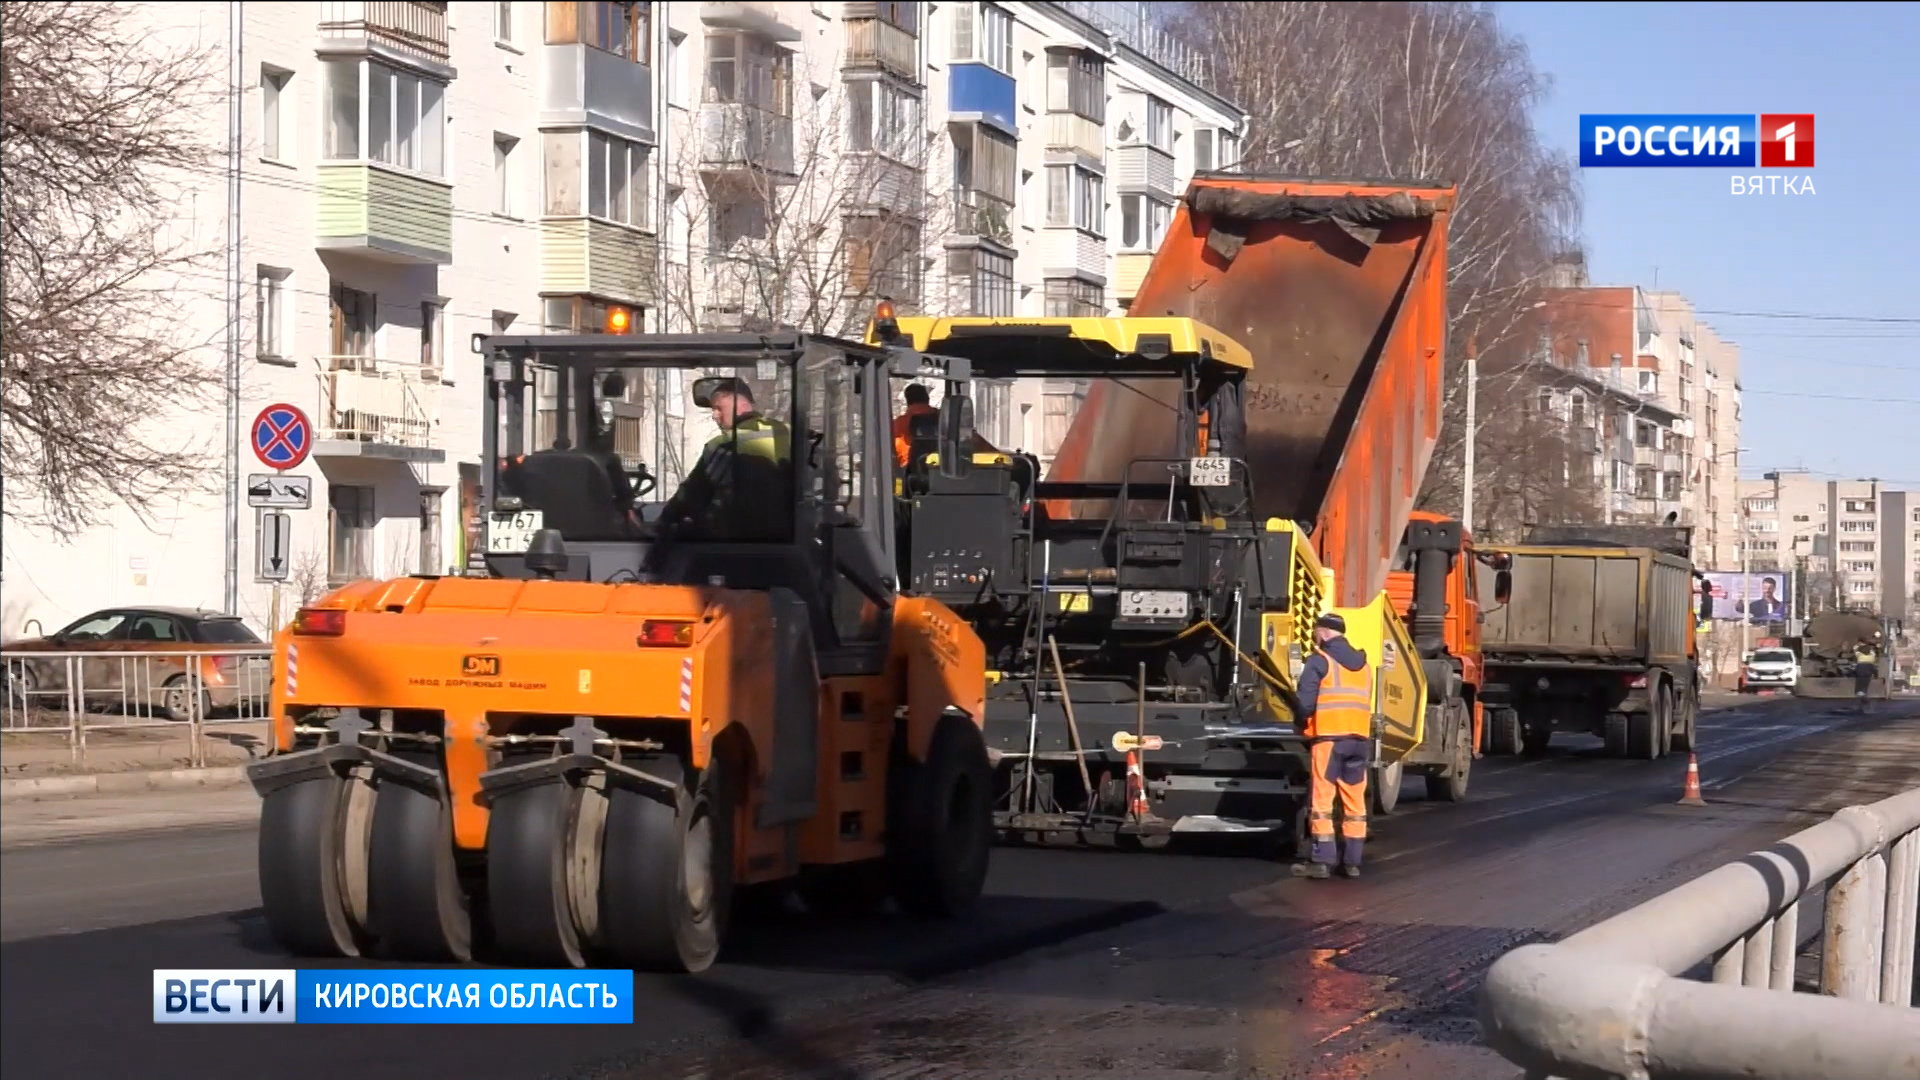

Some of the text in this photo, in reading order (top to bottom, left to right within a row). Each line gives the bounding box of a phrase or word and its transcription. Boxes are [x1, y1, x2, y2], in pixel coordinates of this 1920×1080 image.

[1195, 459, 1225, 471] 4645
[491, 513, 535, 530] 7767
[465, 656, 496, 674] DM
